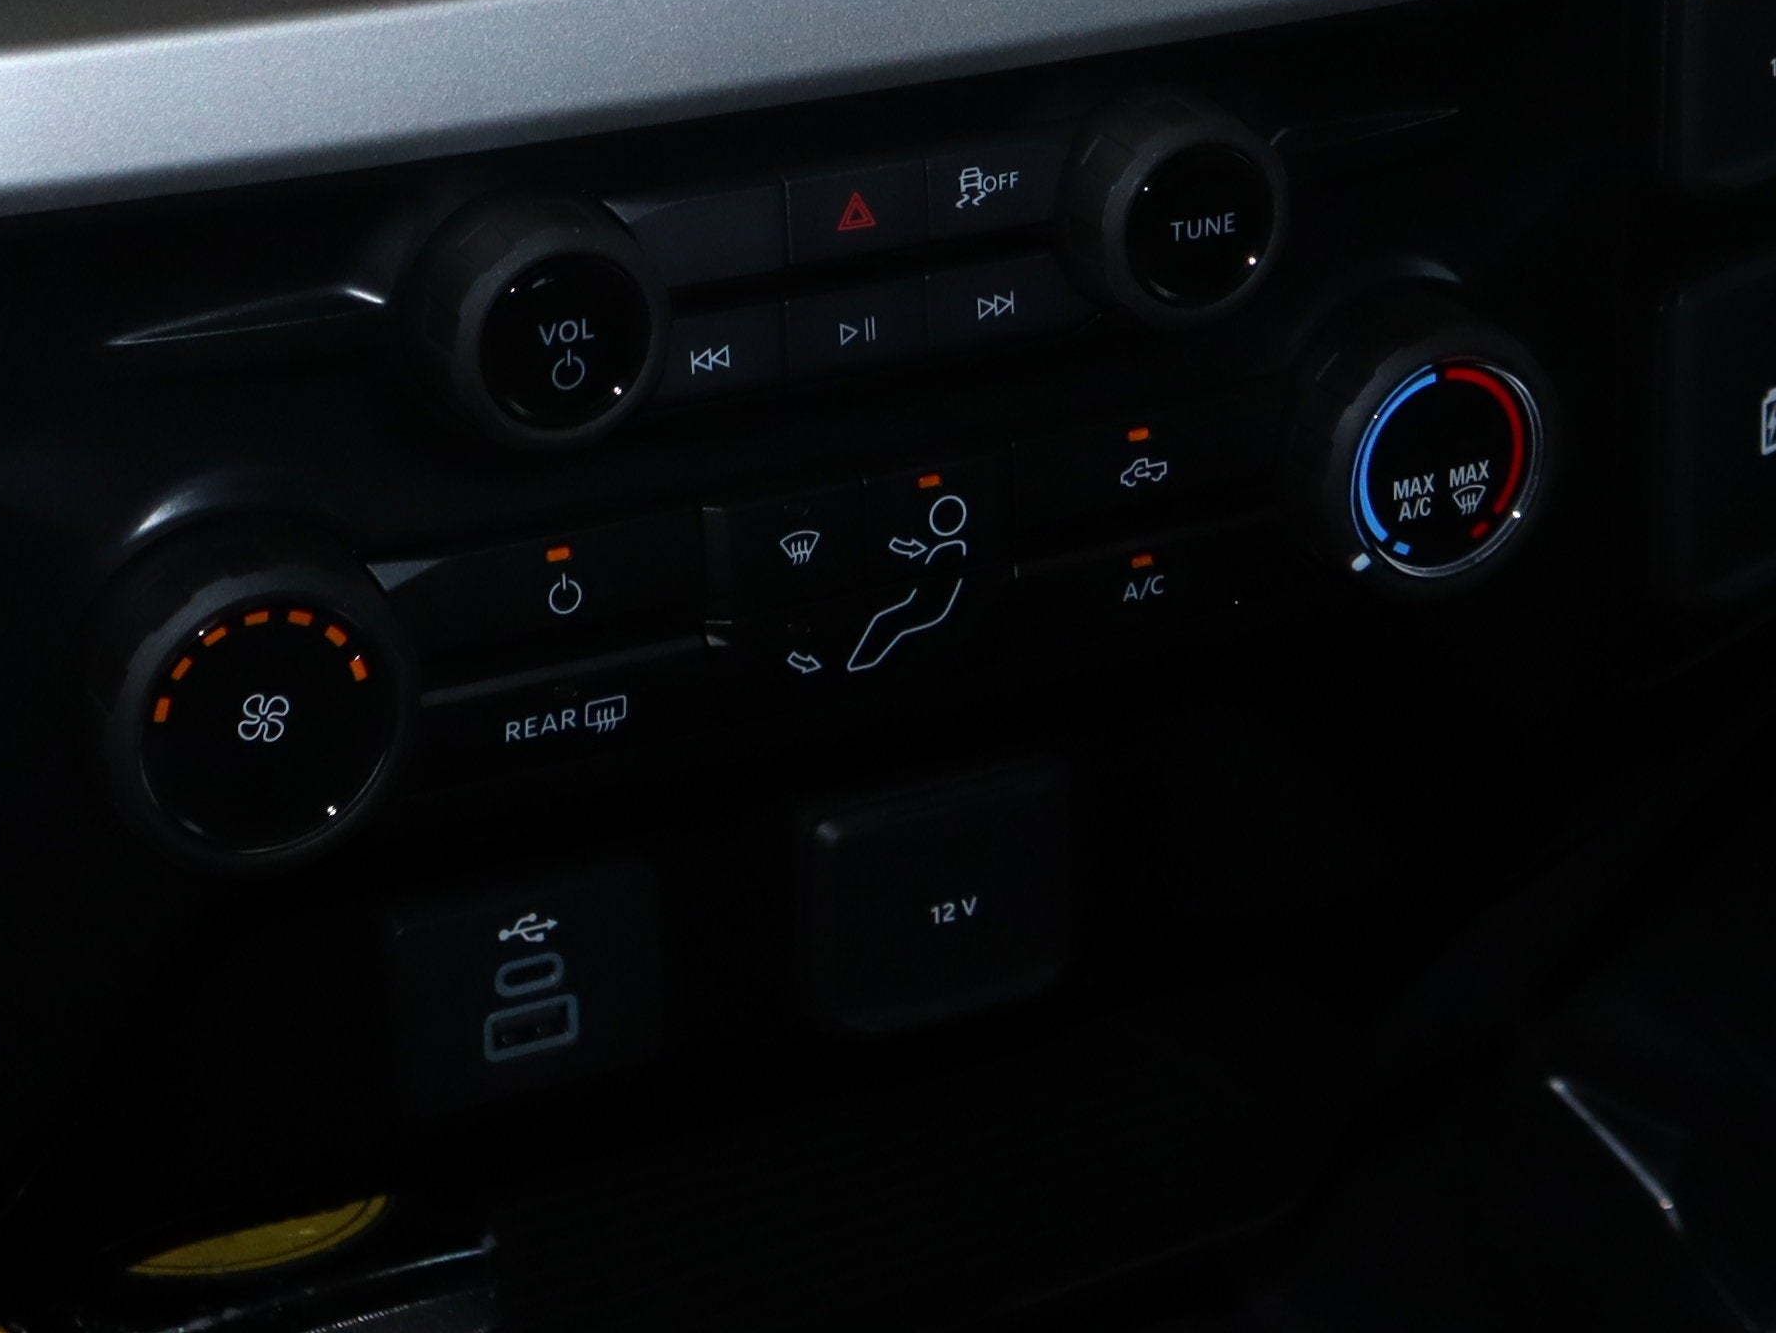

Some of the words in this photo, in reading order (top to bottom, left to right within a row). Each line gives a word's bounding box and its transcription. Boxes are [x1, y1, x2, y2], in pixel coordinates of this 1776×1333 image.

[982, 169, 1020, 194] OFF
[1170, 212, 1238, 243] TUNE
[539, 318, 596, 346] VOL
[1392, 473, 1435, 501] MAX
[1447, 459, 1490, 489] MAX
[1397, 496, 1433, 523] A/C
[1121, 573, 1166, 603] A/C
[504, 708, 578, 743] REAR
[930, 901, 956, 925] 12
[960, 896, 978, 917] V
